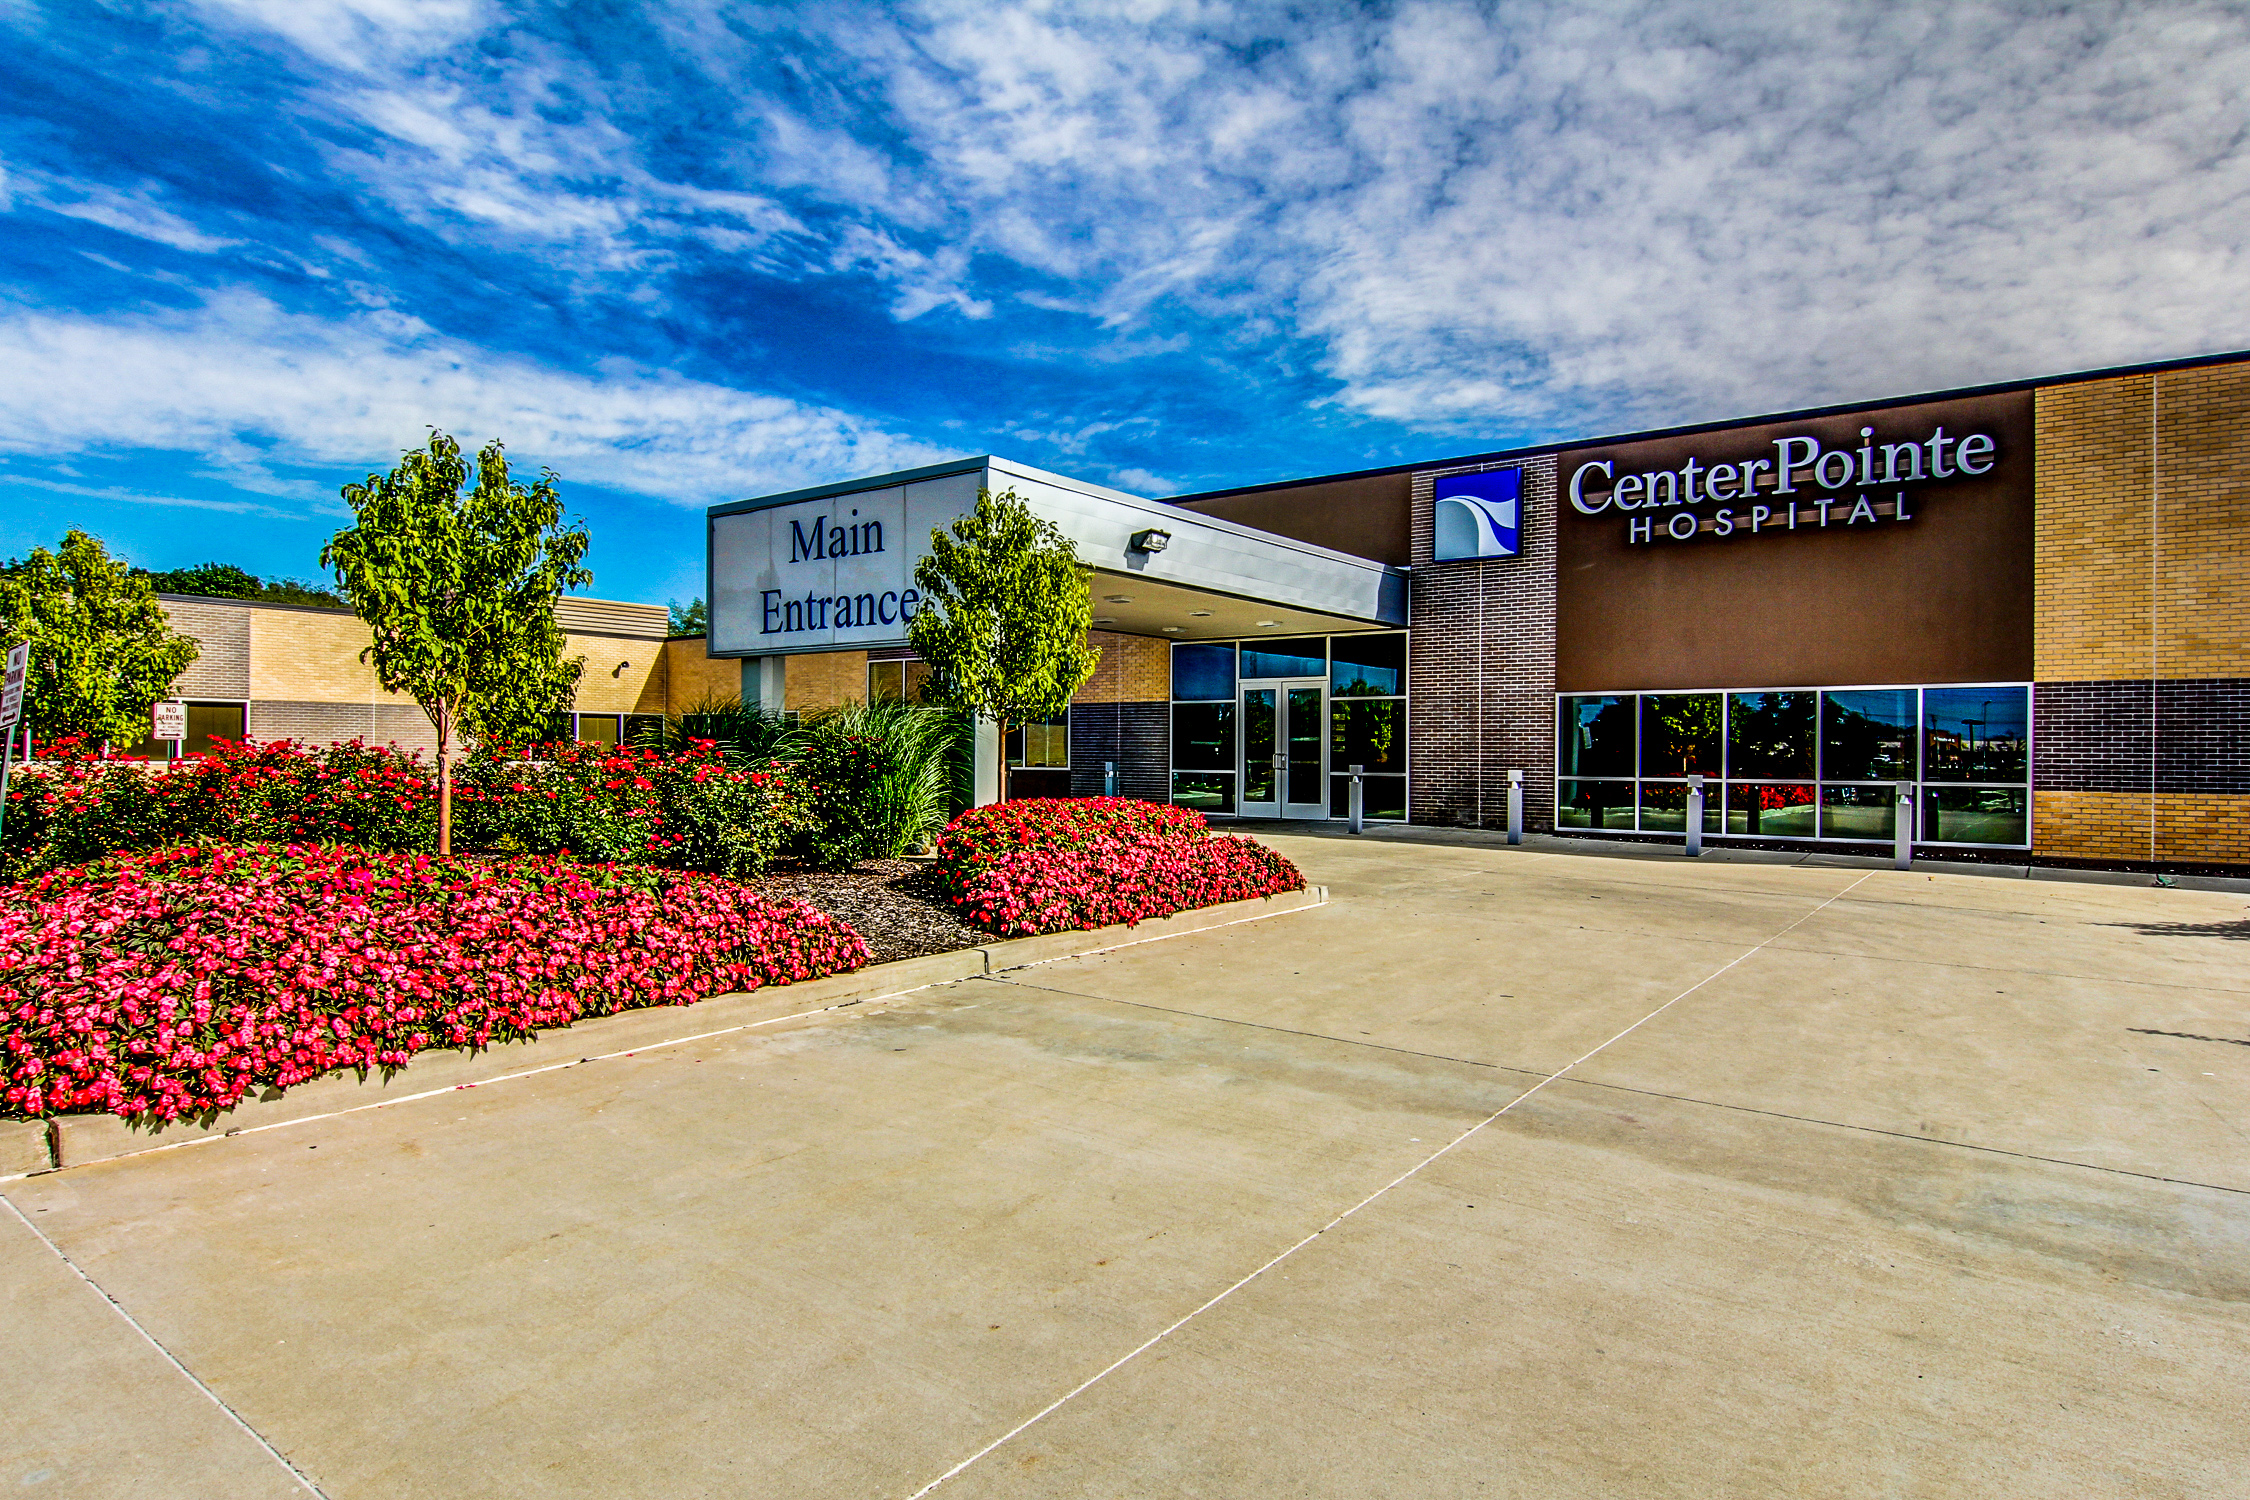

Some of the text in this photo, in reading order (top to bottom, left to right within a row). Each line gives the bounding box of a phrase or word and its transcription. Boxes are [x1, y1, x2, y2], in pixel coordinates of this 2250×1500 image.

[1569, 426, 1996, 514] CenterPointe
[789, 508, 885, 563] Main
[1630, 491, 1913, 544] HOSPITAL
[760, 588, 920, 634] Entrance
[165, 706, 177, 714] NO
